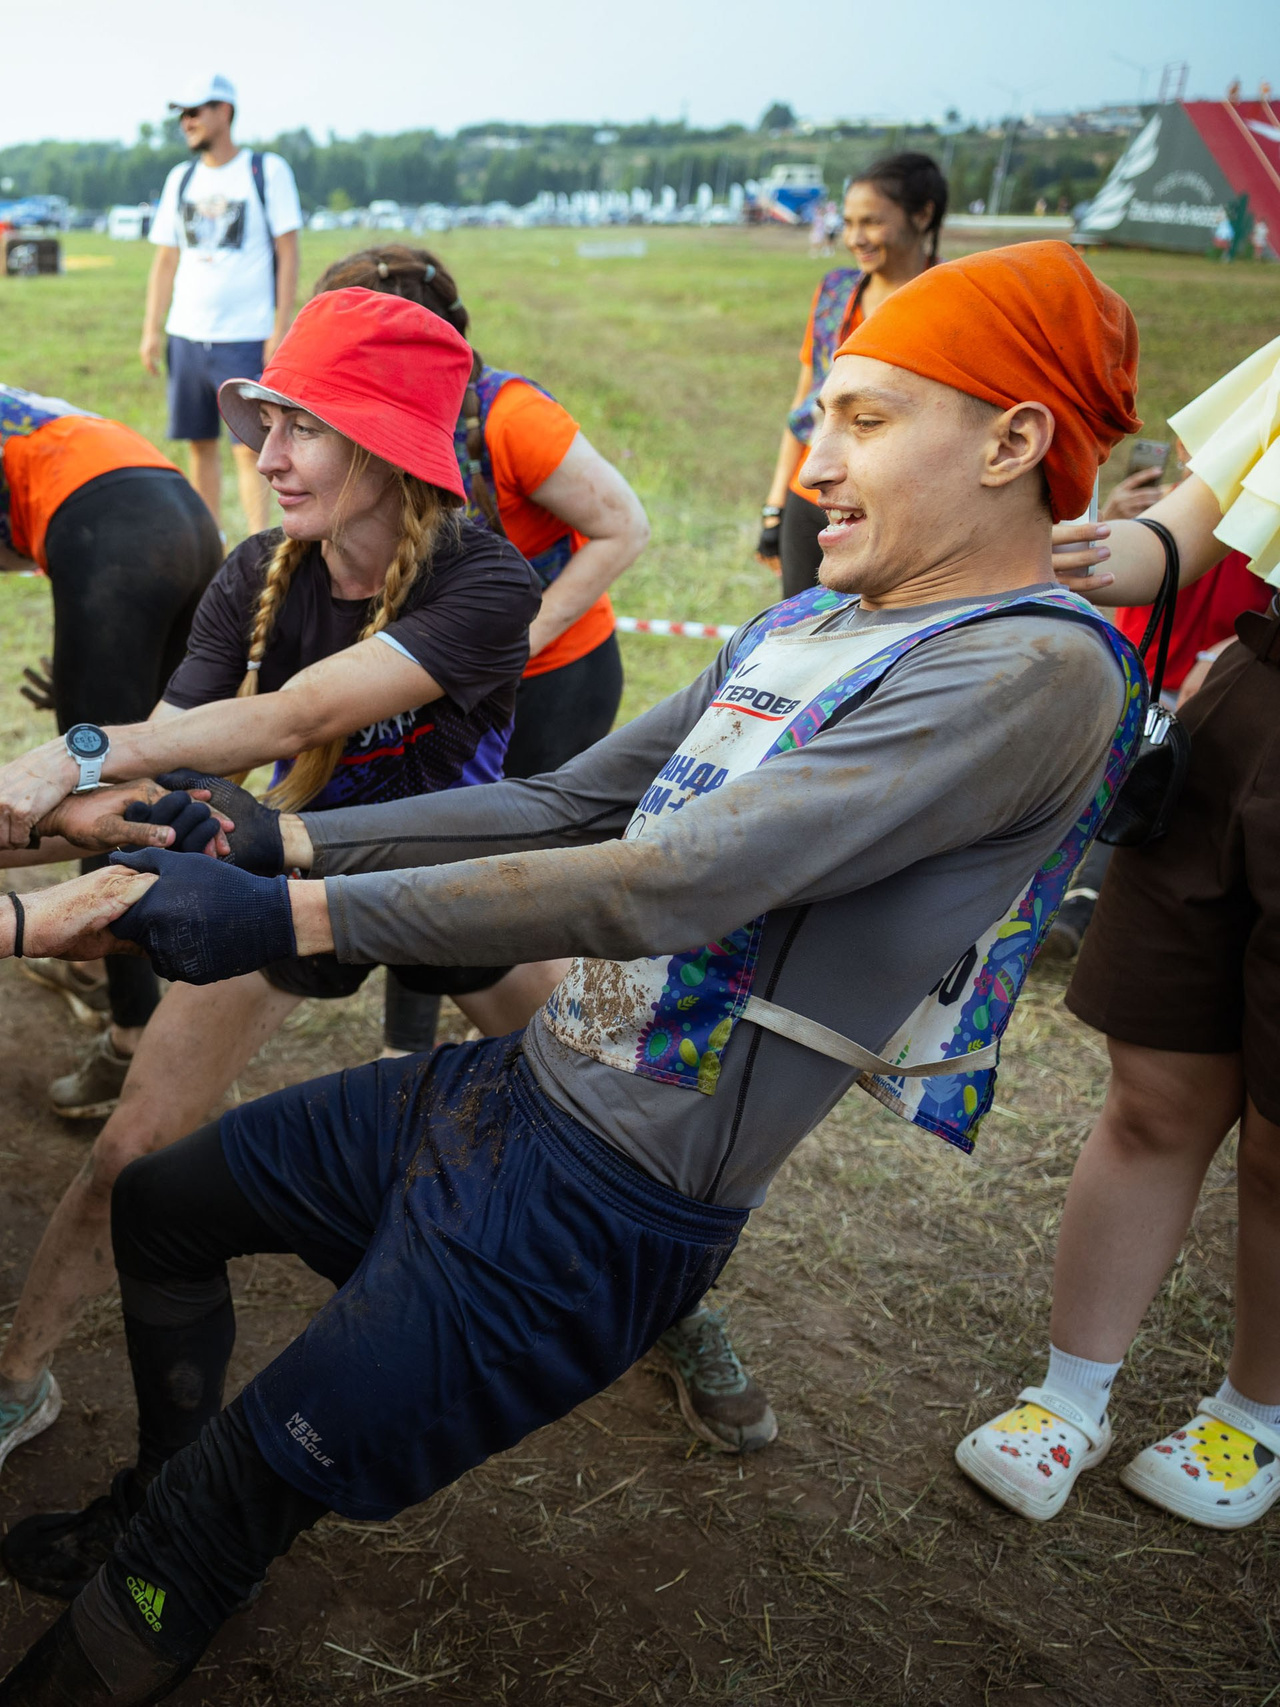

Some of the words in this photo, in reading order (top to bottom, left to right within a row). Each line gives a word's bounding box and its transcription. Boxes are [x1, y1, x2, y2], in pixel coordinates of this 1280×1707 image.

[658, 753, 730, 797] АНДА
[285, 1420, 335, 1467] LEAGUE
[290, 1411, 322, 1443] NEW
[126, 1576, 162, 1632] adidas
